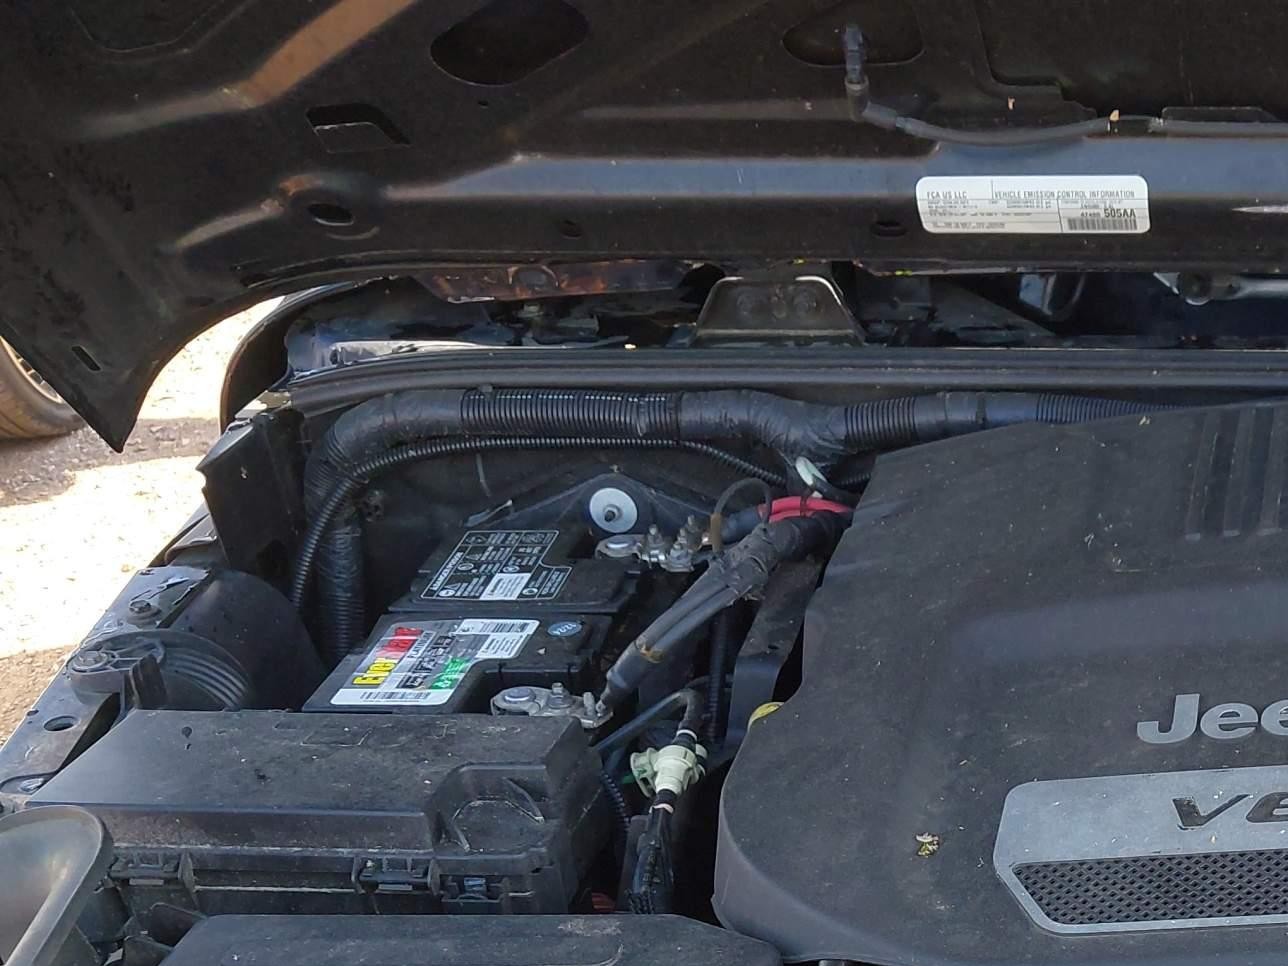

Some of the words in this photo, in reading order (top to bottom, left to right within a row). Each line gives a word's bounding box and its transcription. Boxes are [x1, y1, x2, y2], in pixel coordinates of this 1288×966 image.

[942, 191, 952, 199] US
[954, 191, 967, 199] LLC
[994, 191, 1021, 199] VEHICLE
[1023, 191, 1055, 199] EMISSION
[1057, 190, 1087, 198] CONTROL
[1089, 190, 1135, 198] INFORMATION
[1104, 208, 1136, 218] 505AA
